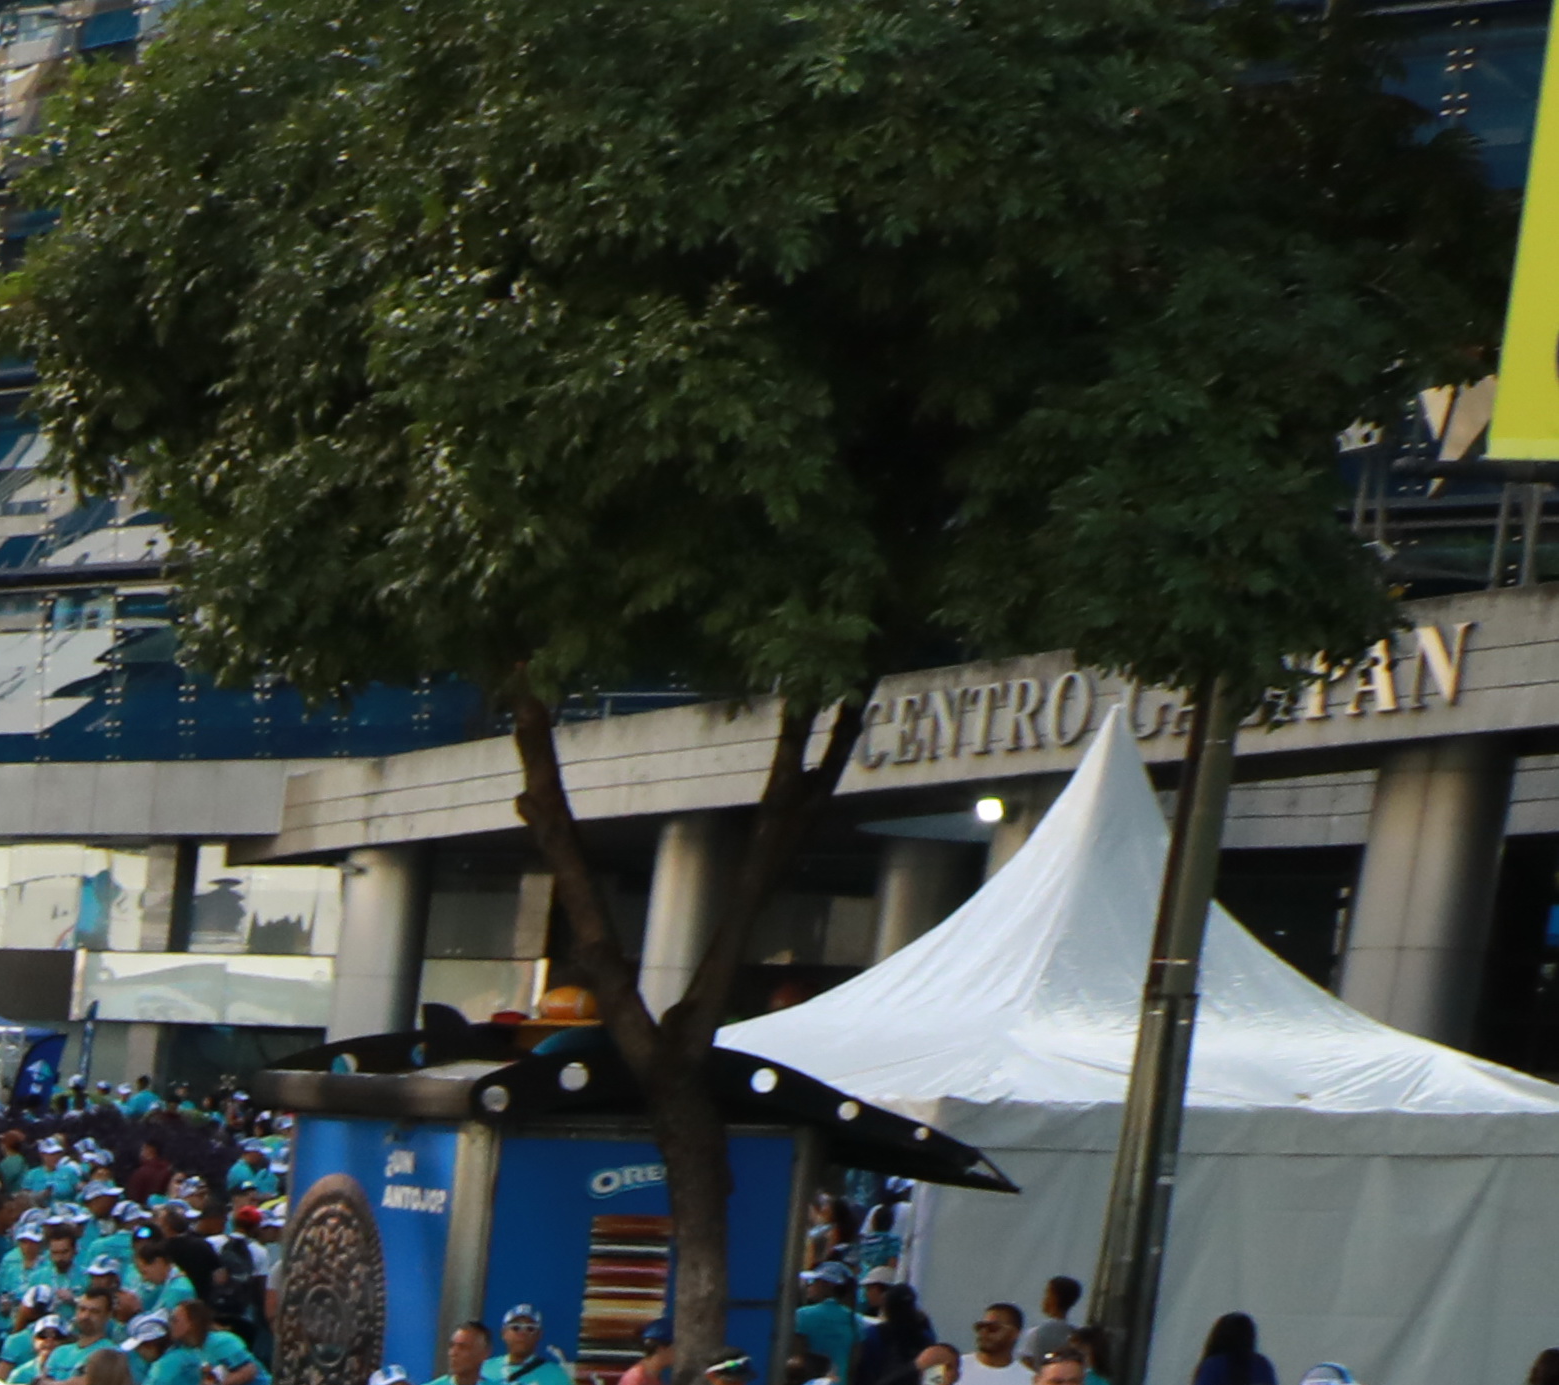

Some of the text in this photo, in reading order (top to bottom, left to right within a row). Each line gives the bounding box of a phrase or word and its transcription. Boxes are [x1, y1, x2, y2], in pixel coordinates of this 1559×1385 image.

[855, 670, 1095, 768] CENTRO
[590, 1163, 665, 1194] ORE
[381, 1184, 447, 1213] ANTOJO?
